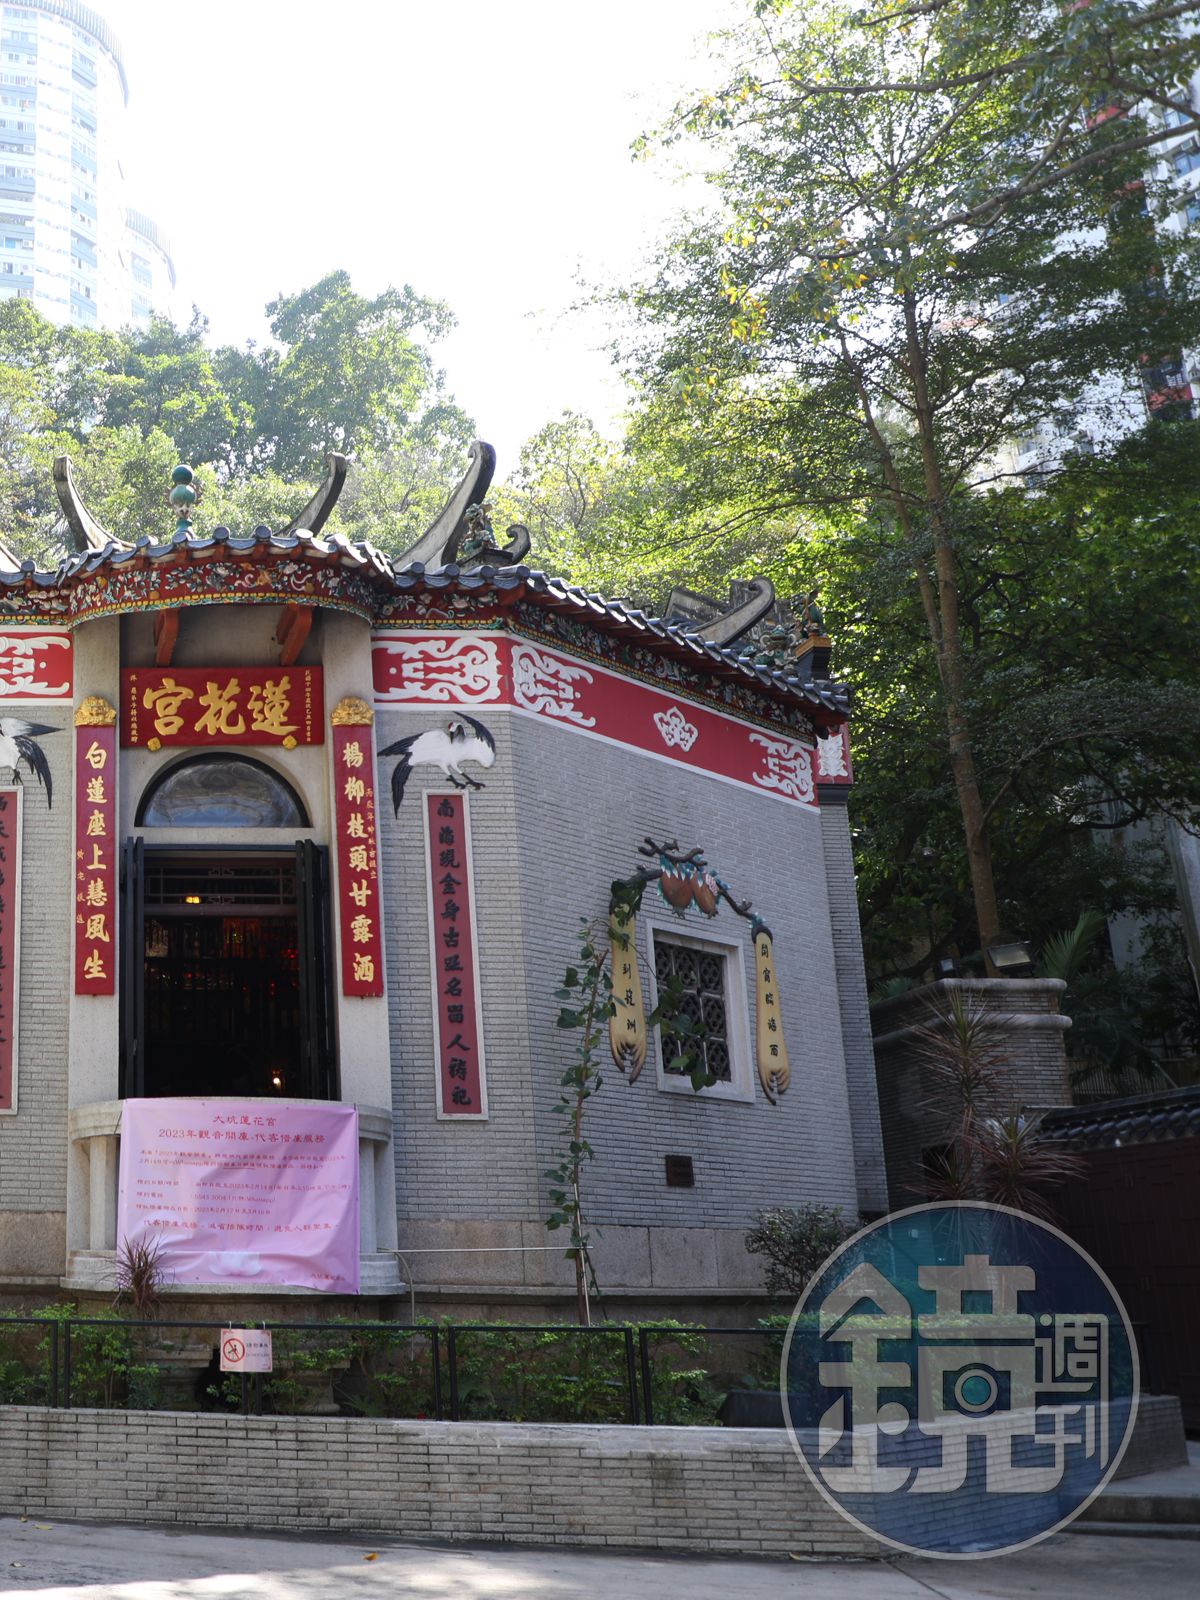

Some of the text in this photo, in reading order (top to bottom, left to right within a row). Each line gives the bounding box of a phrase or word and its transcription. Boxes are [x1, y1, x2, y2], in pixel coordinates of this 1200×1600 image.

[143, 676, 301, 736] 蓮花宮
[84, 741, 110, 980] 白蓮座上慧風生
[212, 1113, 277, 1127] 大坑蓮花宮
